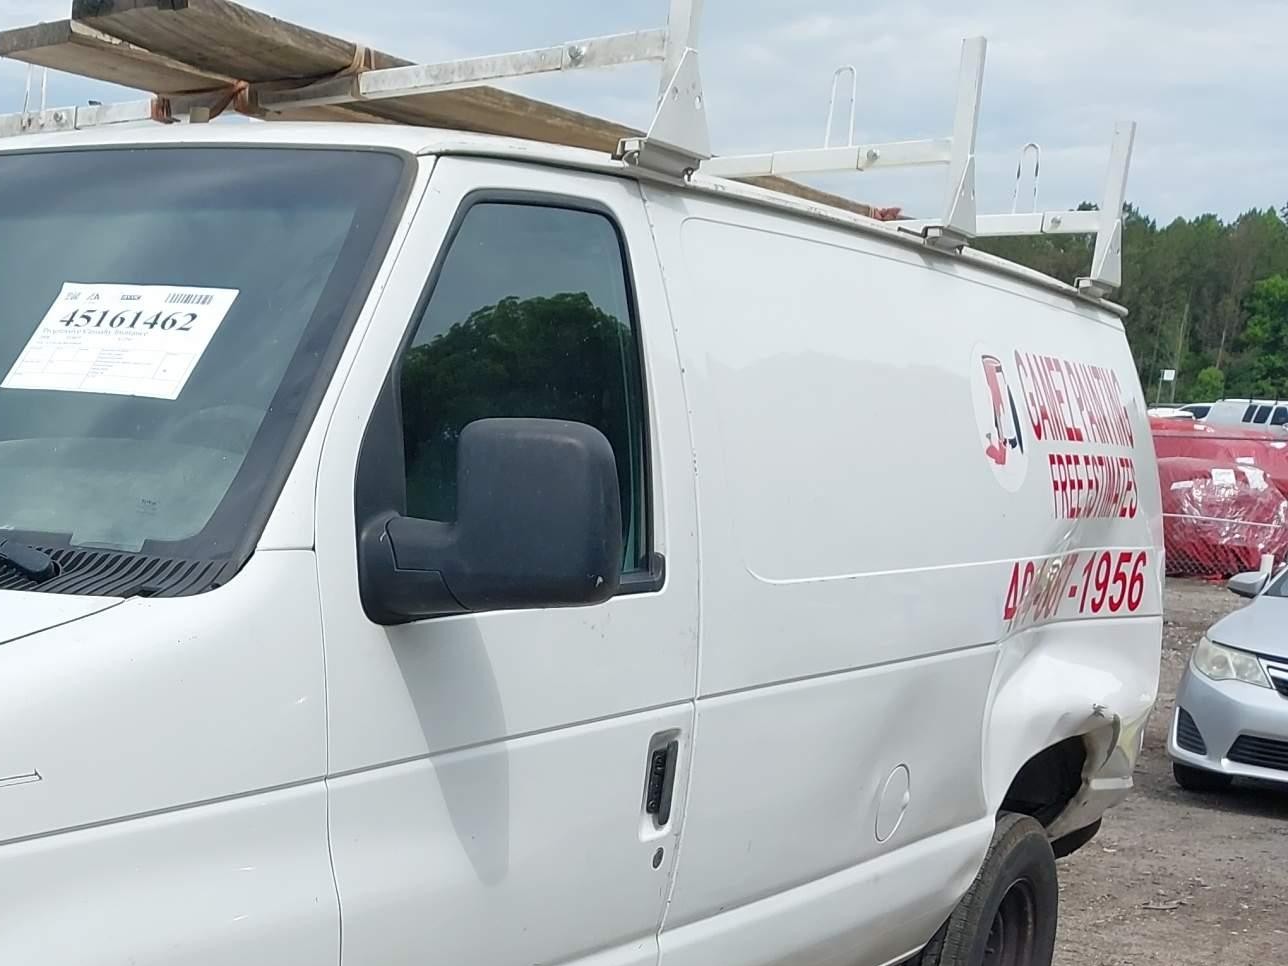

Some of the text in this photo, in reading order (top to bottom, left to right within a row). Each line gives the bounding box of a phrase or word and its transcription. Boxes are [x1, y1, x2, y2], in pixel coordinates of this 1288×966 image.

[59, 308, 199, 332] 45161462
[1048, 453, 1139, 519] FREE ESTIMATES
